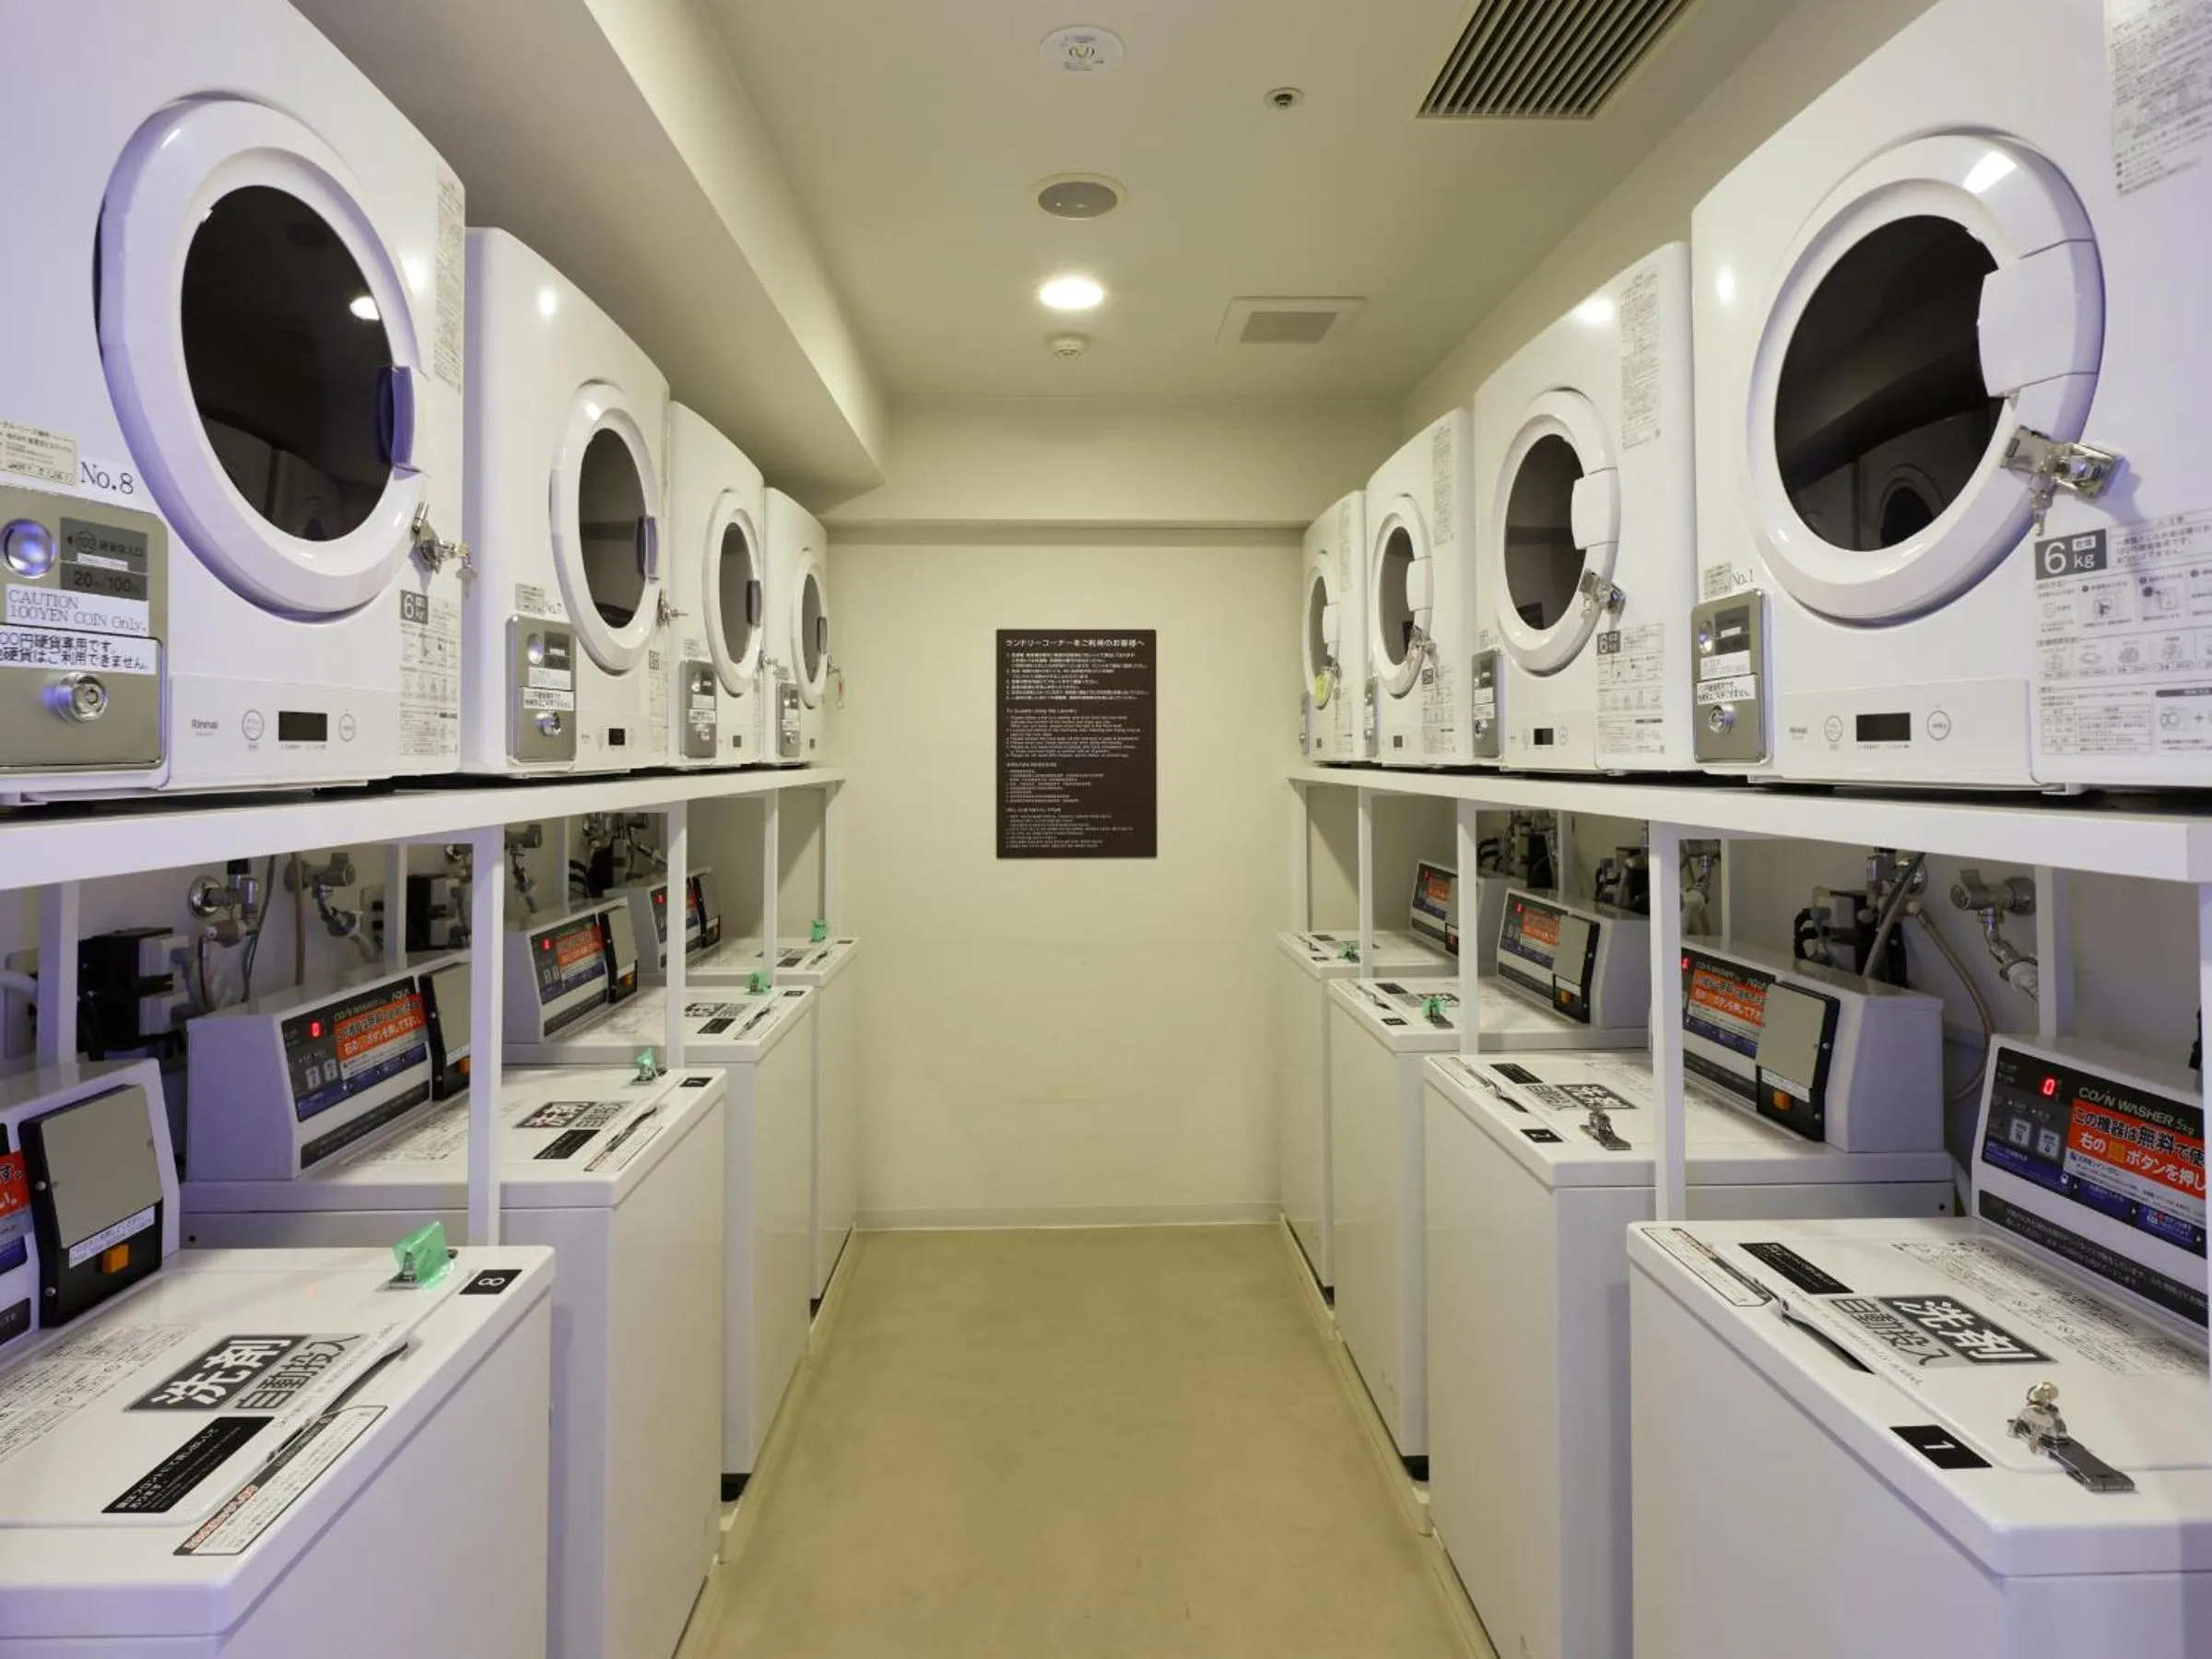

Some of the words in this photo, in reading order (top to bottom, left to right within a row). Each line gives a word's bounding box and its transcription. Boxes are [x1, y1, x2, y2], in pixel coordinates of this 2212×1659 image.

[80, 461, 135, 495] No.8
[2044, 541, 2067, 575] 6
[2074, 553, 2095, 570] kg
[7, 590, 79, 610] CAUTION
[74, 611, 108, 627] COIN
[0, 631, 117, 654] 00円硬貨専用です。
[0, 646, 149, 670] 硬貨はご利用できません。
[2041, 1077, 2056, 1096] 0
[2118, 1100, 2174, 1126] WASHER
[1830, 1298, 1951, 1367] 自動投入
[1892, 1300, 2039, 1359] 洗剤
[150, 1339, 292, 1406] 洗剤
[234, 1335, 361, 1409] 自動投入
